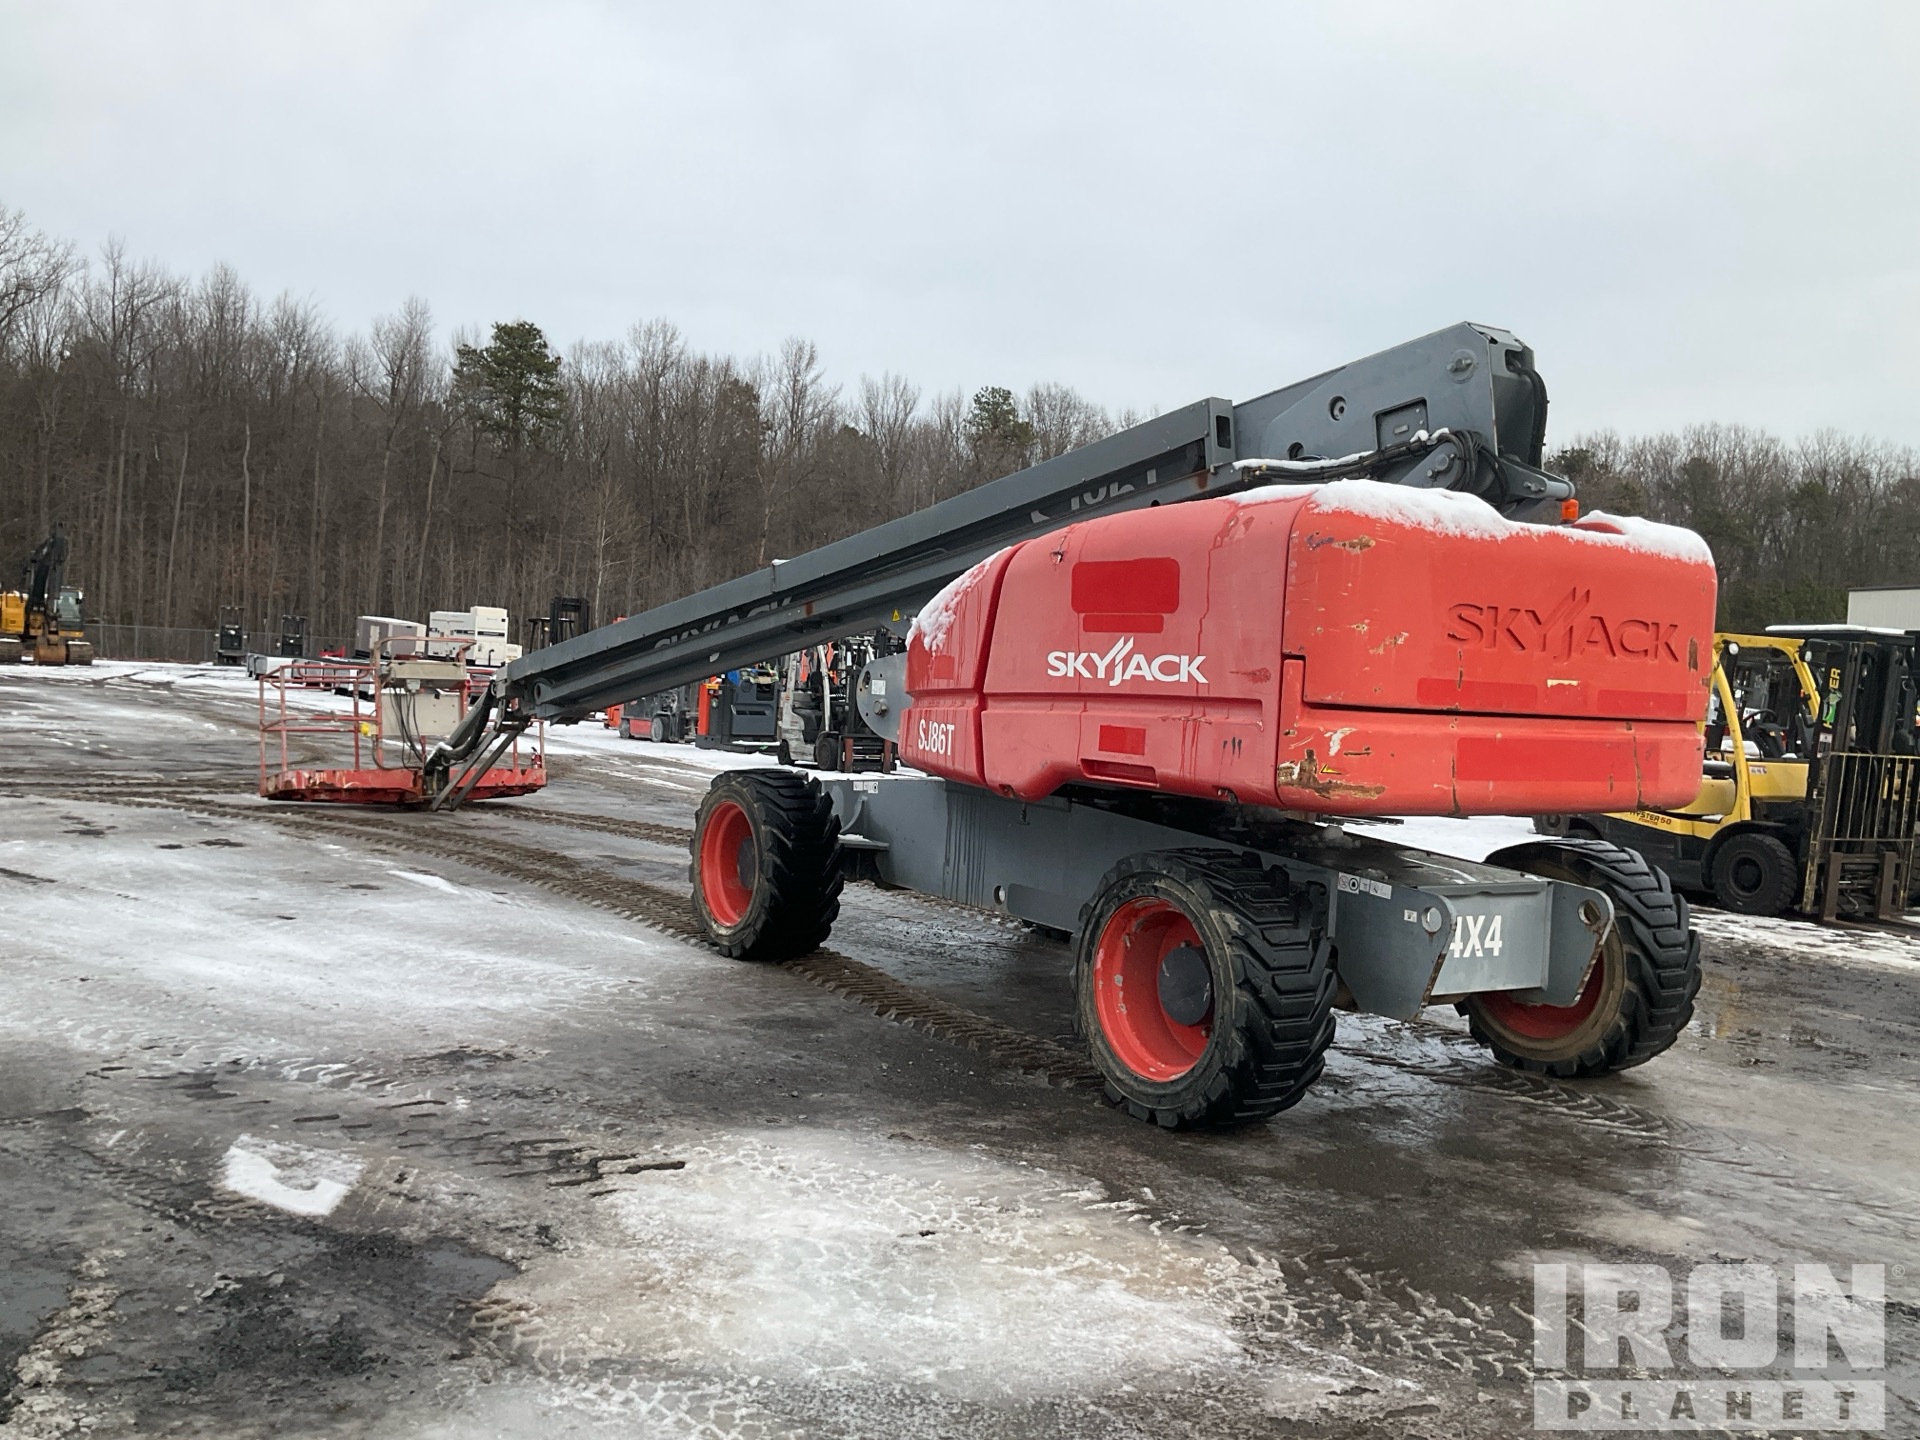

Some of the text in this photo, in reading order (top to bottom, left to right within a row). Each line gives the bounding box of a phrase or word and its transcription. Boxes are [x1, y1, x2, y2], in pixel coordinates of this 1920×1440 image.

[1446, 586, 1680, 665] SKYJACK
[1047, 635, 1210, 687] SKYJACK
[918, 718, 955, 756] SJ86T
[1660, 816, 1672, 825] 50
[1449, 914, 1503, 959] 4X4
